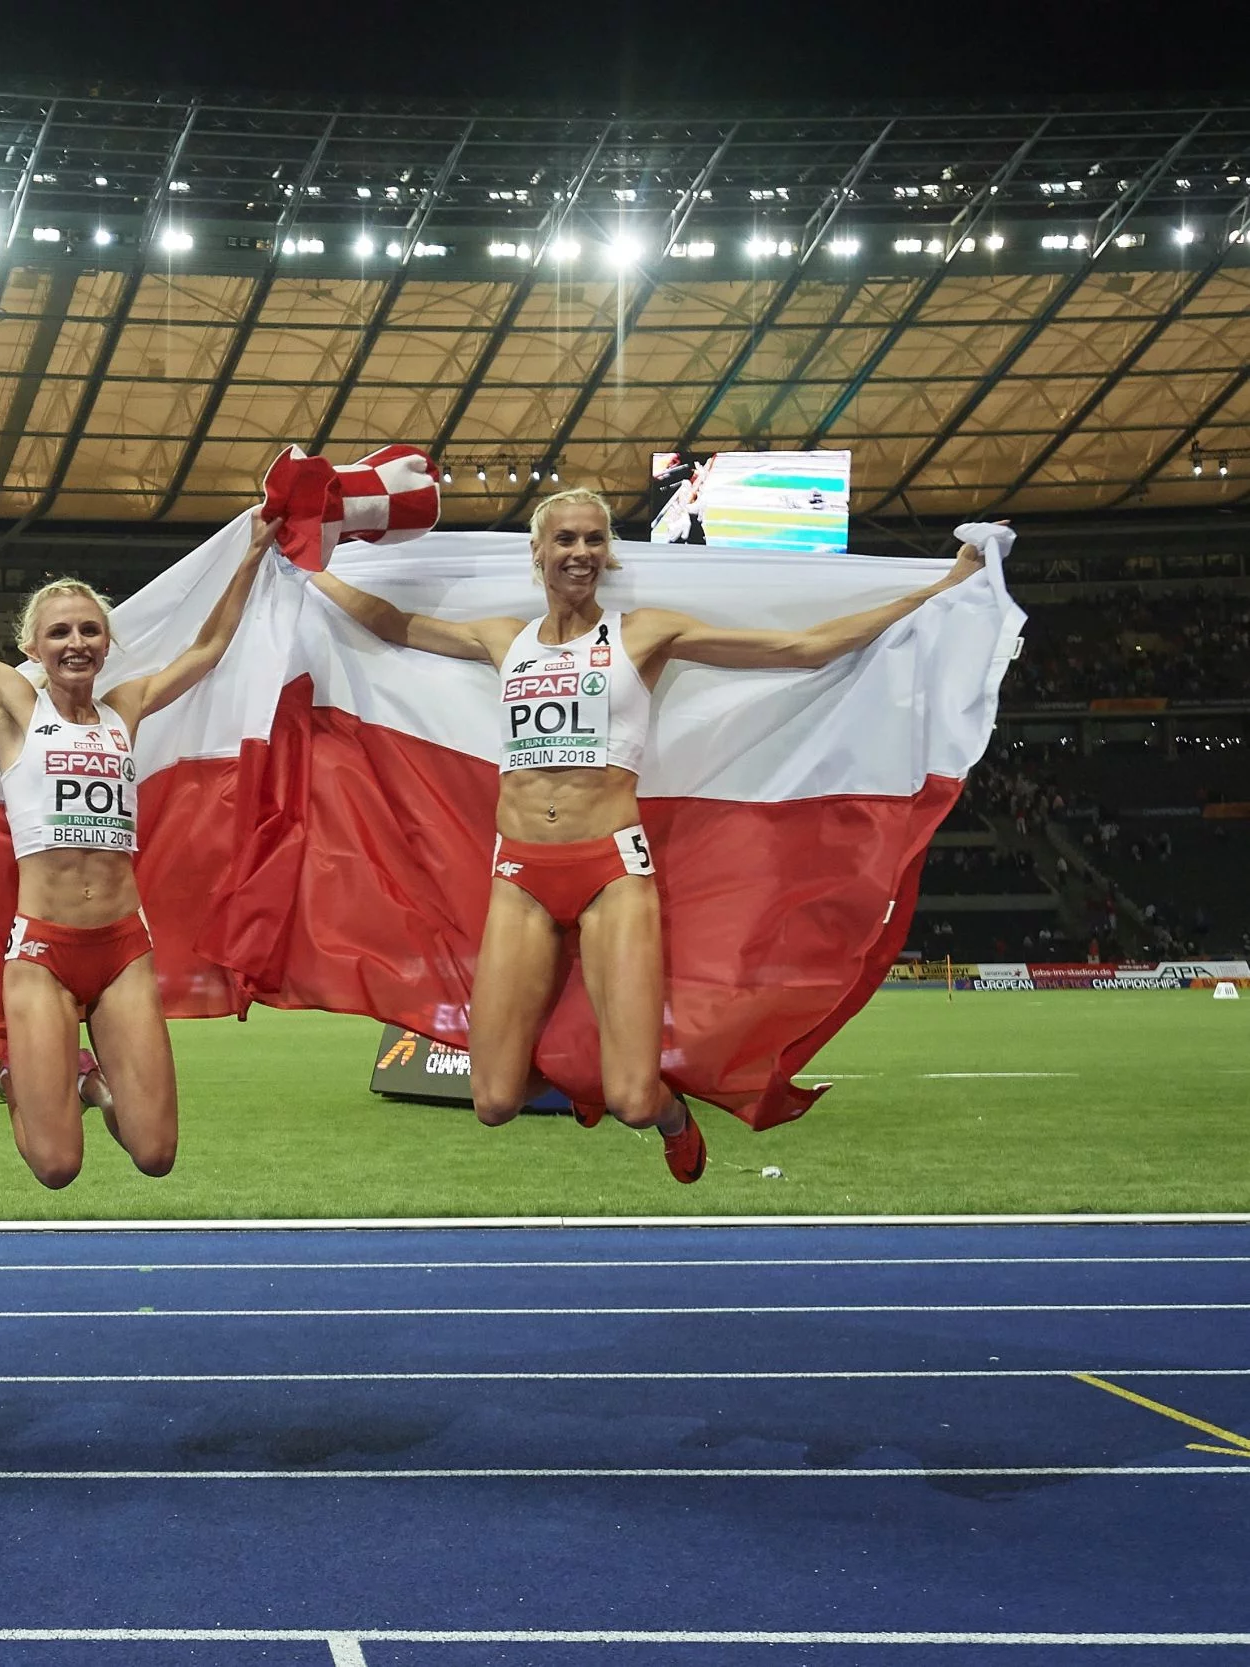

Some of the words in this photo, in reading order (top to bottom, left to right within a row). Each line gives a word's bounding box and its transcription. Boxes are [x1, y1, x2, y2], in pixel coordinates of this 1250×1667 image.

[505, 676, 577, 699] SPAR
[510, 701, 595, 738] POL
[75, 742, 102, 750] ORLEN
[525, 738, 542, 748] RUN
[47, 753, 120, 775] SPAR
[510, 750, 553, 767] BERLIN
[558, 750, 596, 763] 2018
[55, 779, 132, 817] POL
[73, 816, 95, 825] RUN
[53, 828, 106, 843] BERLIN
[631, 834, 650, 868] 5
[973, 979, 1034, 991] EUROPEAN
[1092, 978, 1181, 991] CHAMPIONSHIPS
